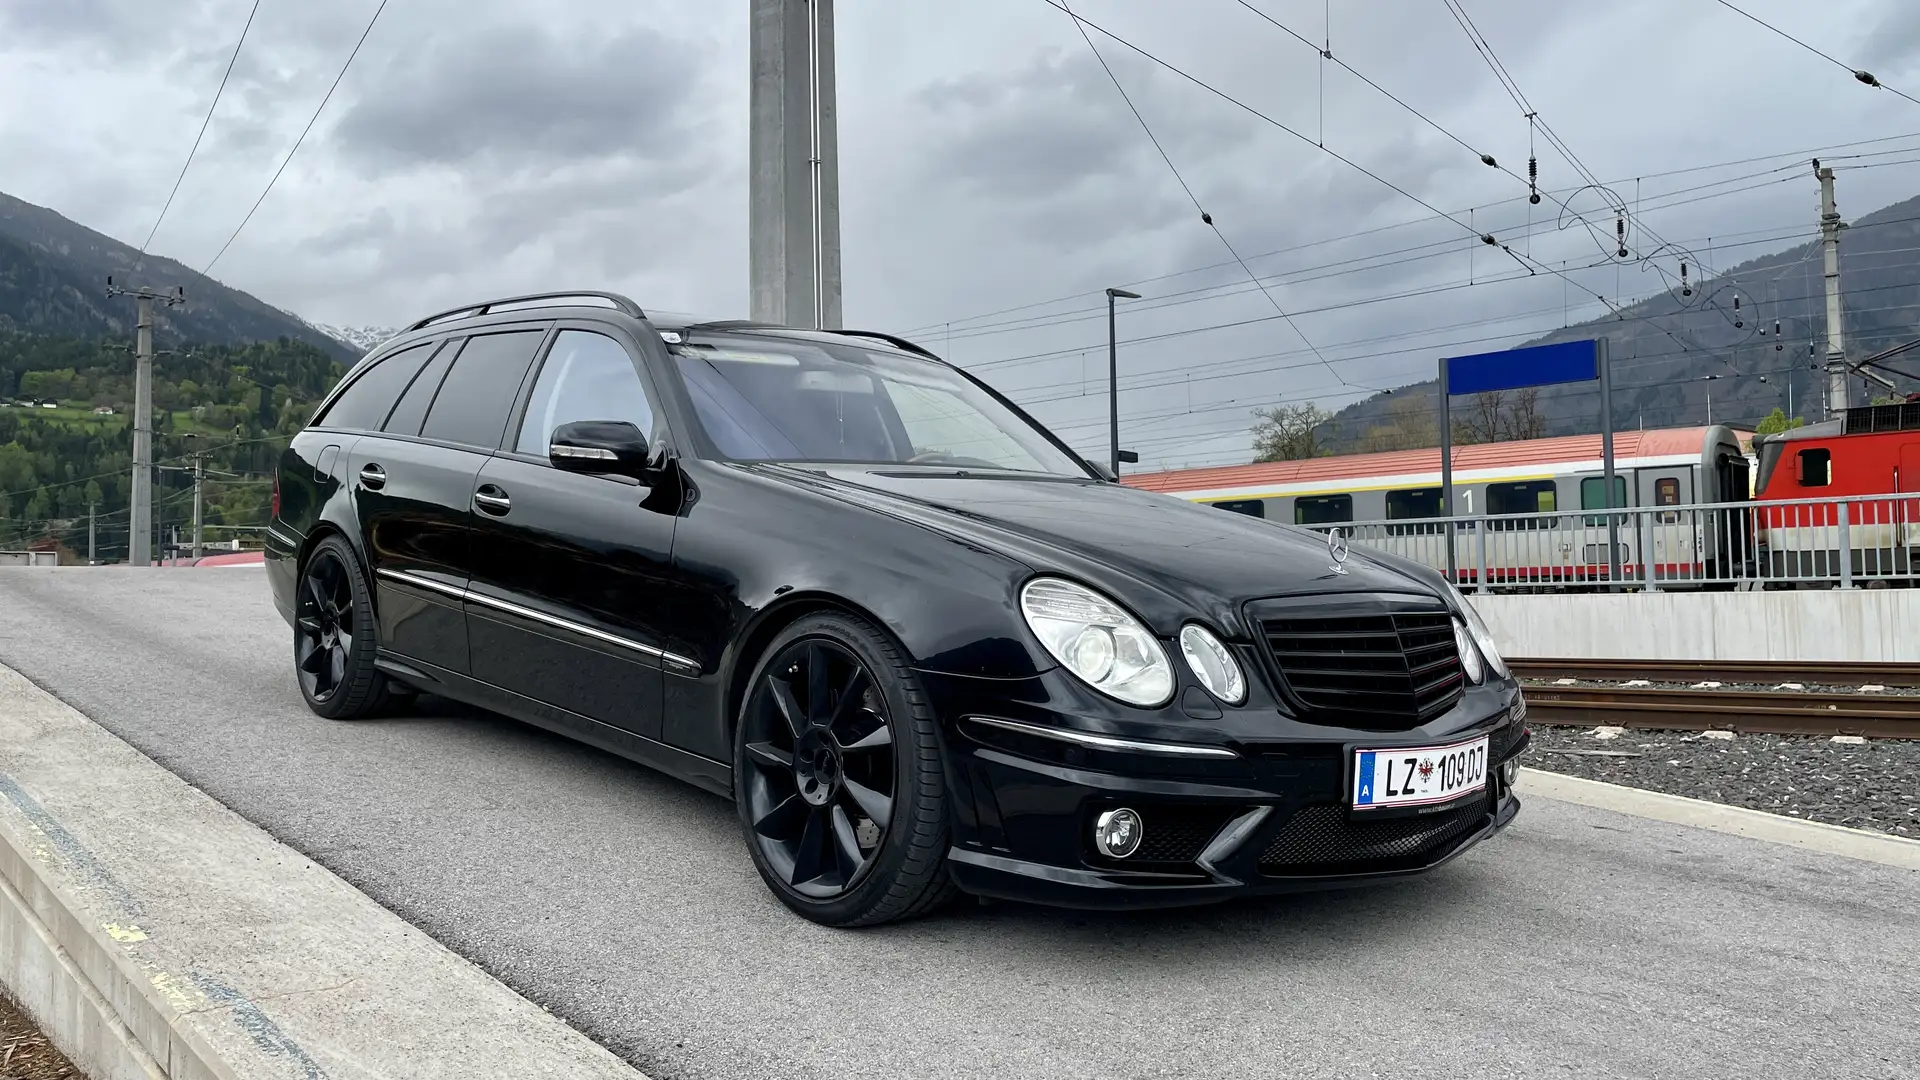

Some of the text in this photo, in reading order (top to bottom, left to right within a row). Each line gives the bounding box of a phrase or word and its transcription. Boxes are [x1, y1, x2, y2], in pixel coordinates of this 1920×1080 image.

[1462, 489, 1473, 513] 1
[1386, 758, 1417, 797] LZ
[1361, 785, 1370, 797] A
